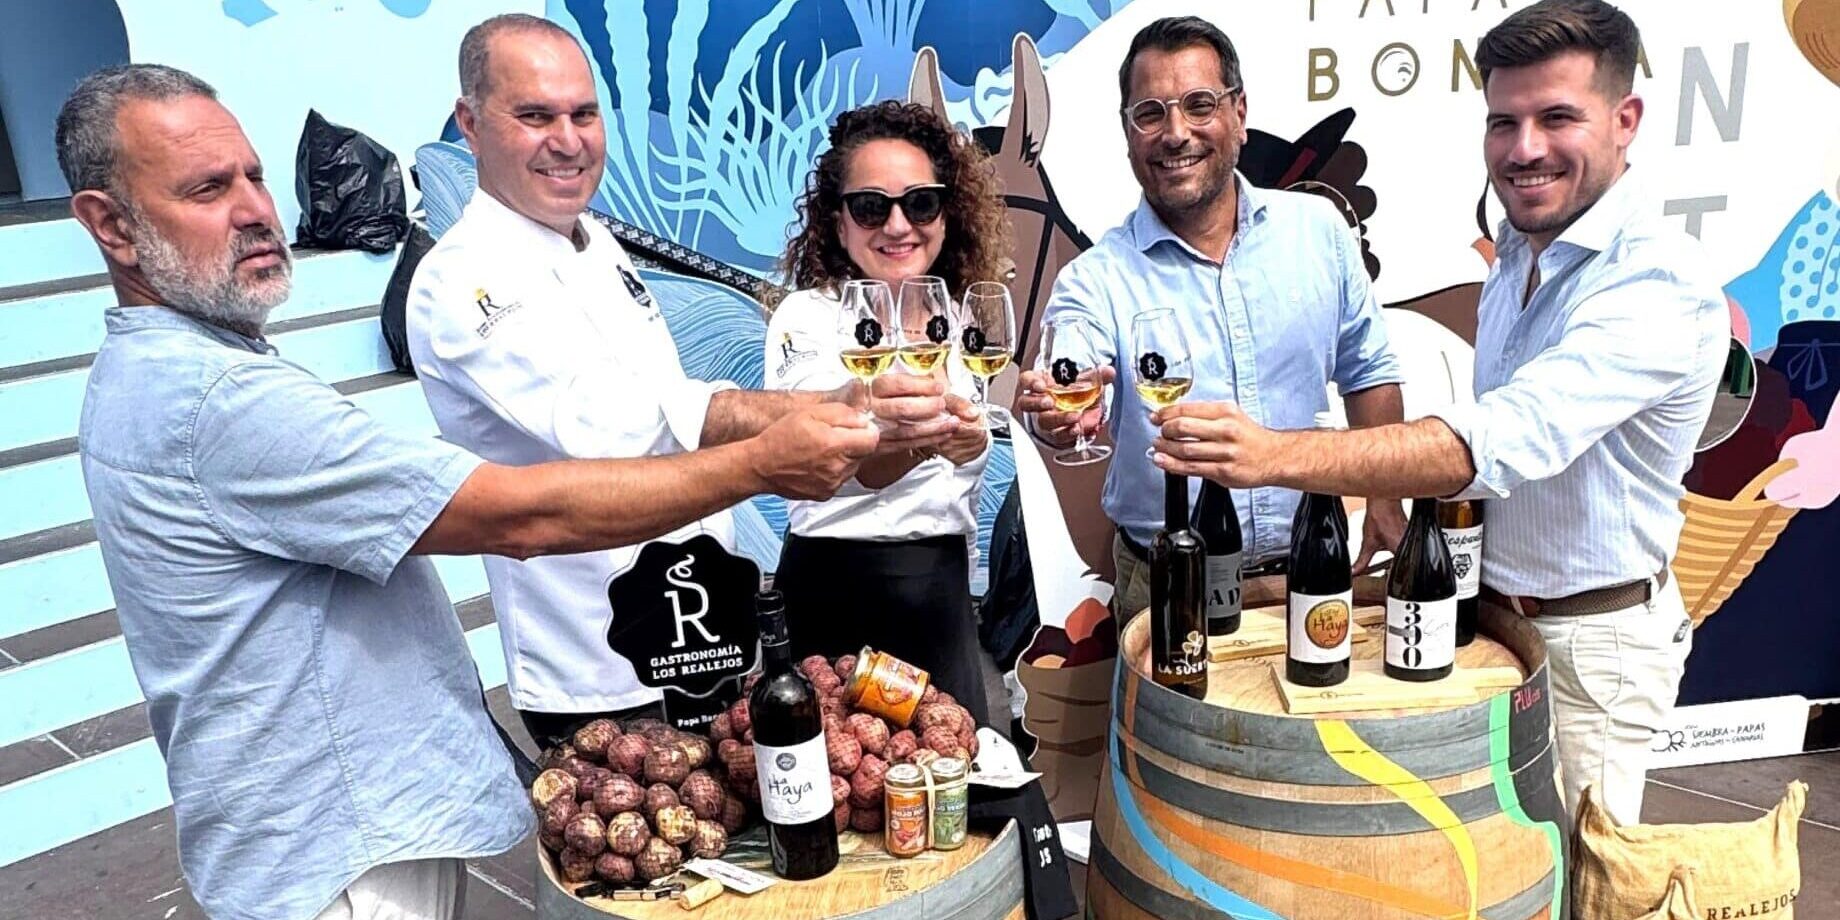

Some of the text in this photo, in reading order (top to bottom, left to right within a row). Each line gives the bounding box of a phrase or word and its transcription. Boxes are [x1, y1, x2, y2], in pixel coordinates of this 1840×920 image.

[650, 644, 743, 668] GASTRONOMÍA
[1175, 658, 1207, 676] SUERT
[652, 657, 744, 680] LOS REALEJOS
[1736, 722, 1766, 734] PAPAS
[768, 778, 813, 805] Haya
[1707, 888, 1797, 920] REALEJOS
